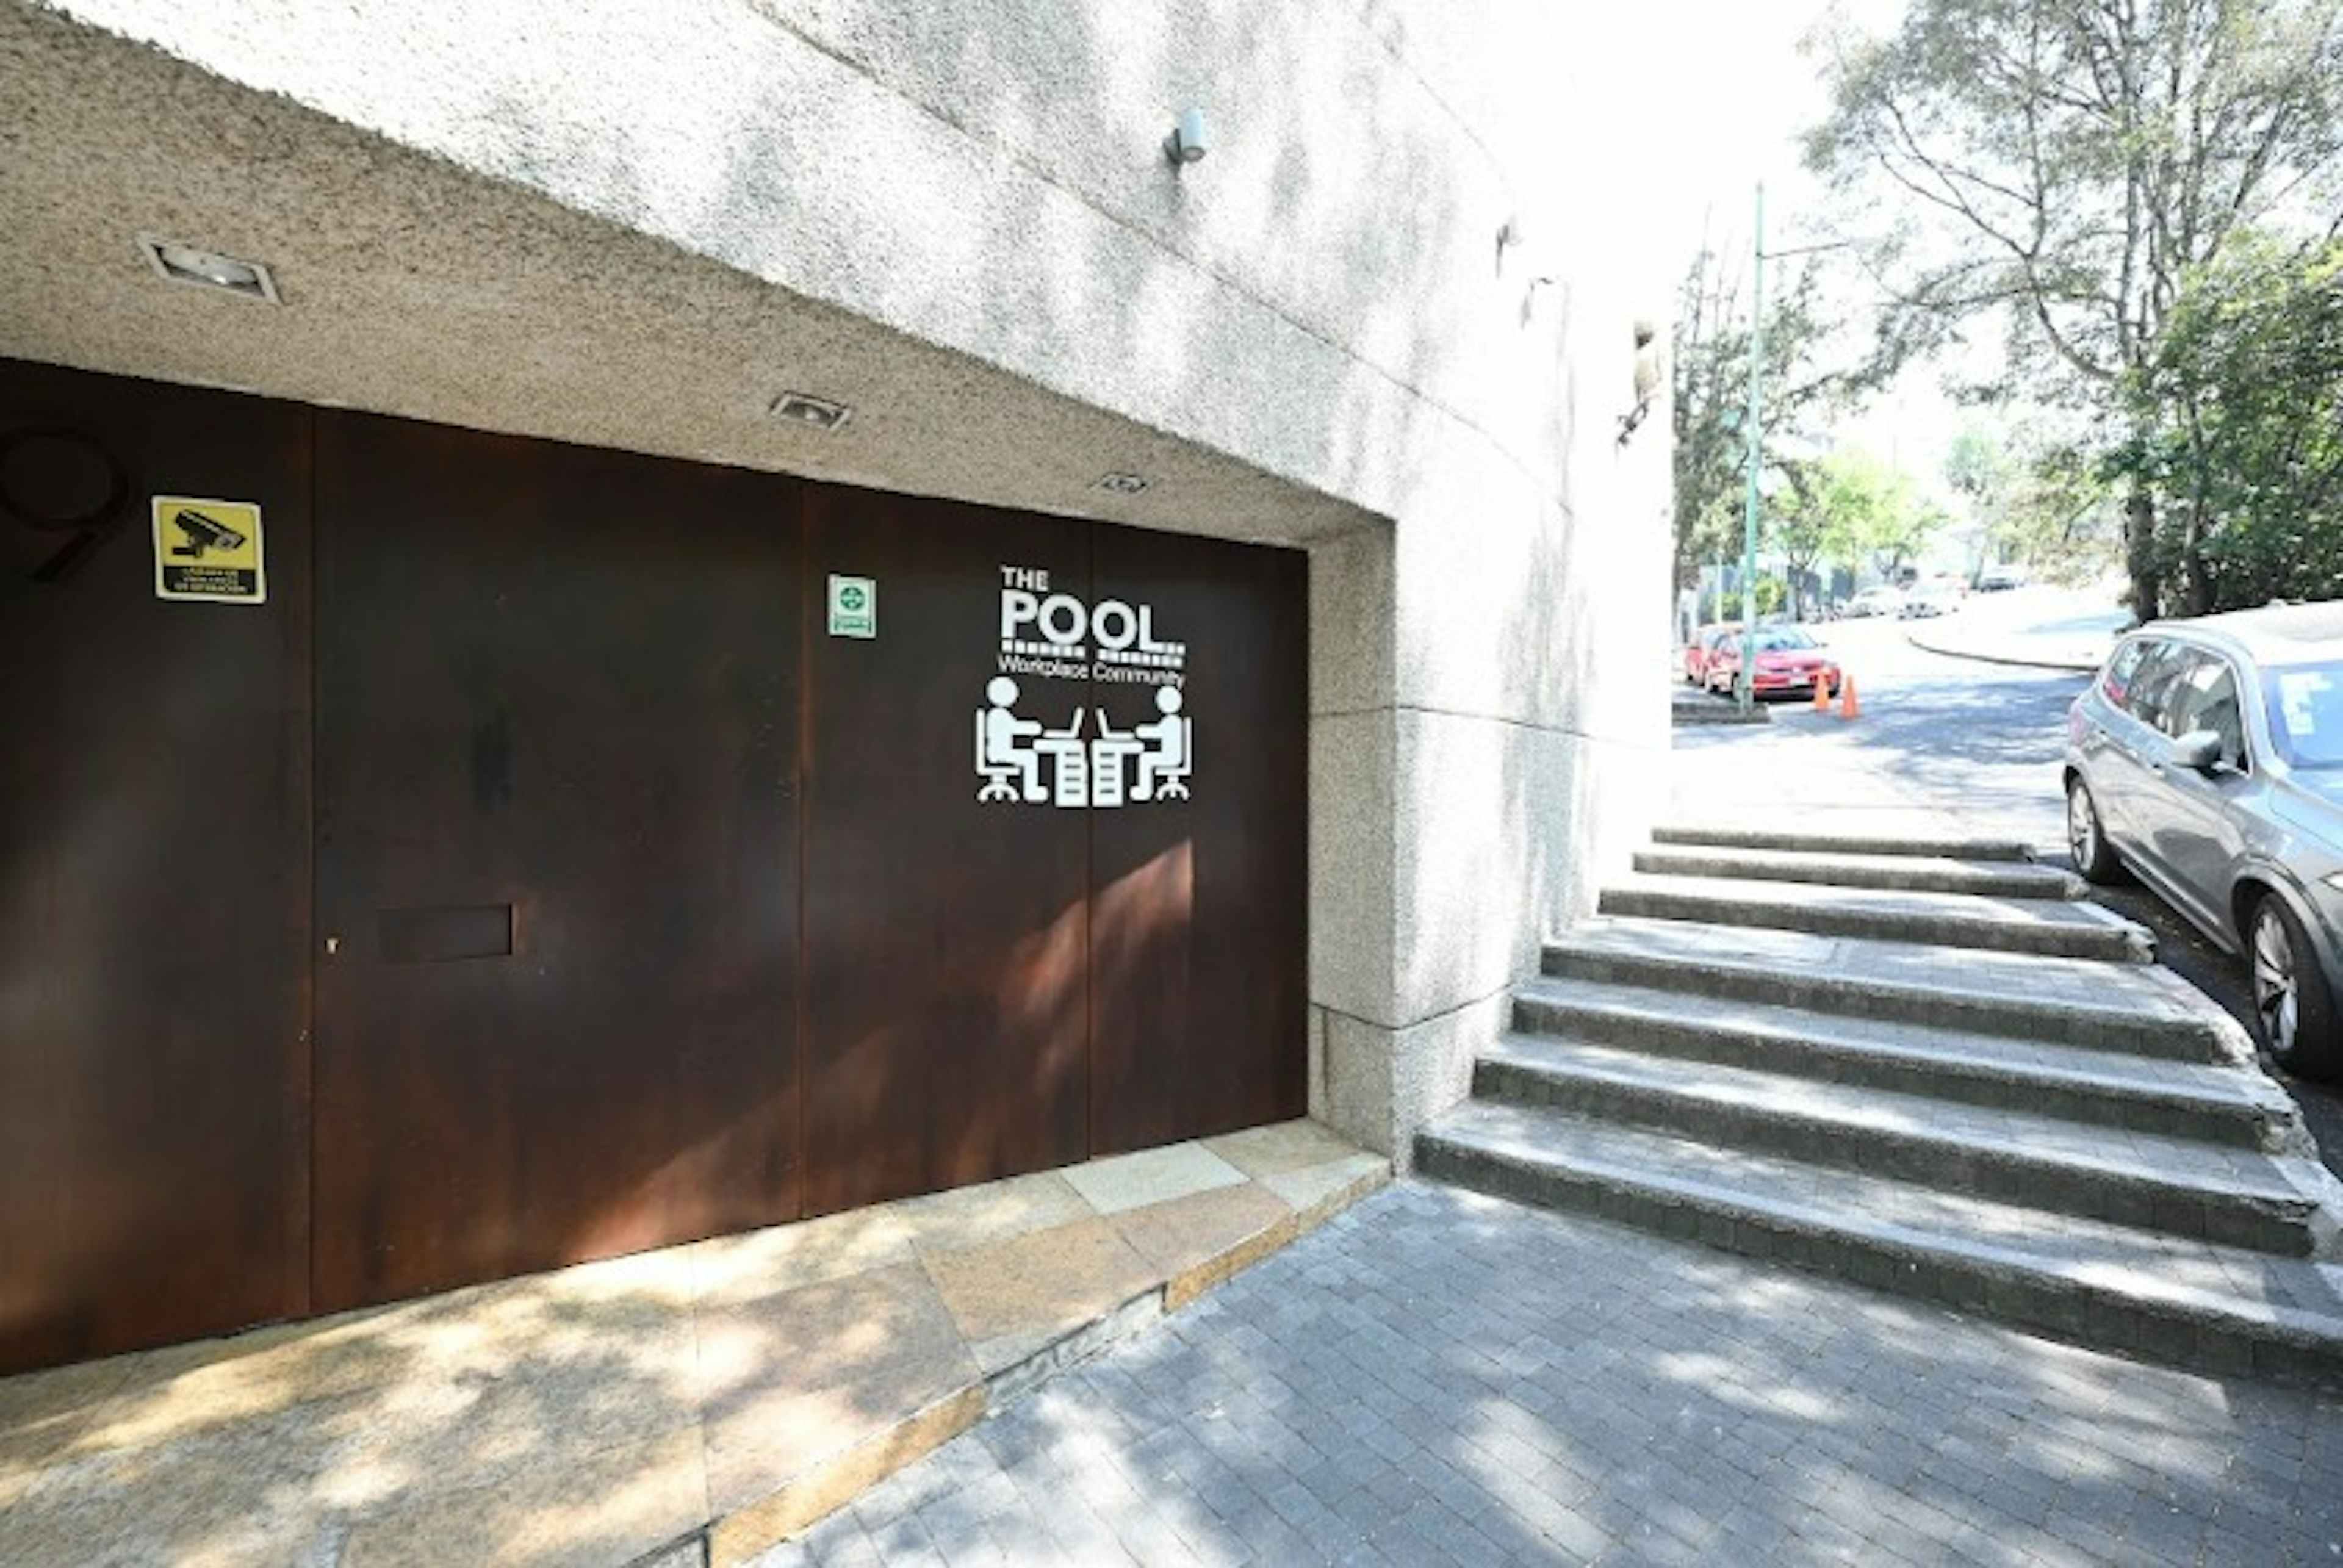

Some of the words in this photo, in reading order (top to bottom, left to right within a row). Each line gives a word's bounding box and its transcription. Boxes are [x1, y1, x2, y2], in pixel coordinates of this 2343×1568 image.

[1001, 566, 1049, 591] THE
[1001, 589, 1164, 652] POOL
[998, 654, 1089, 679] Workplace
[1093, 661, 1186, 691] Community
